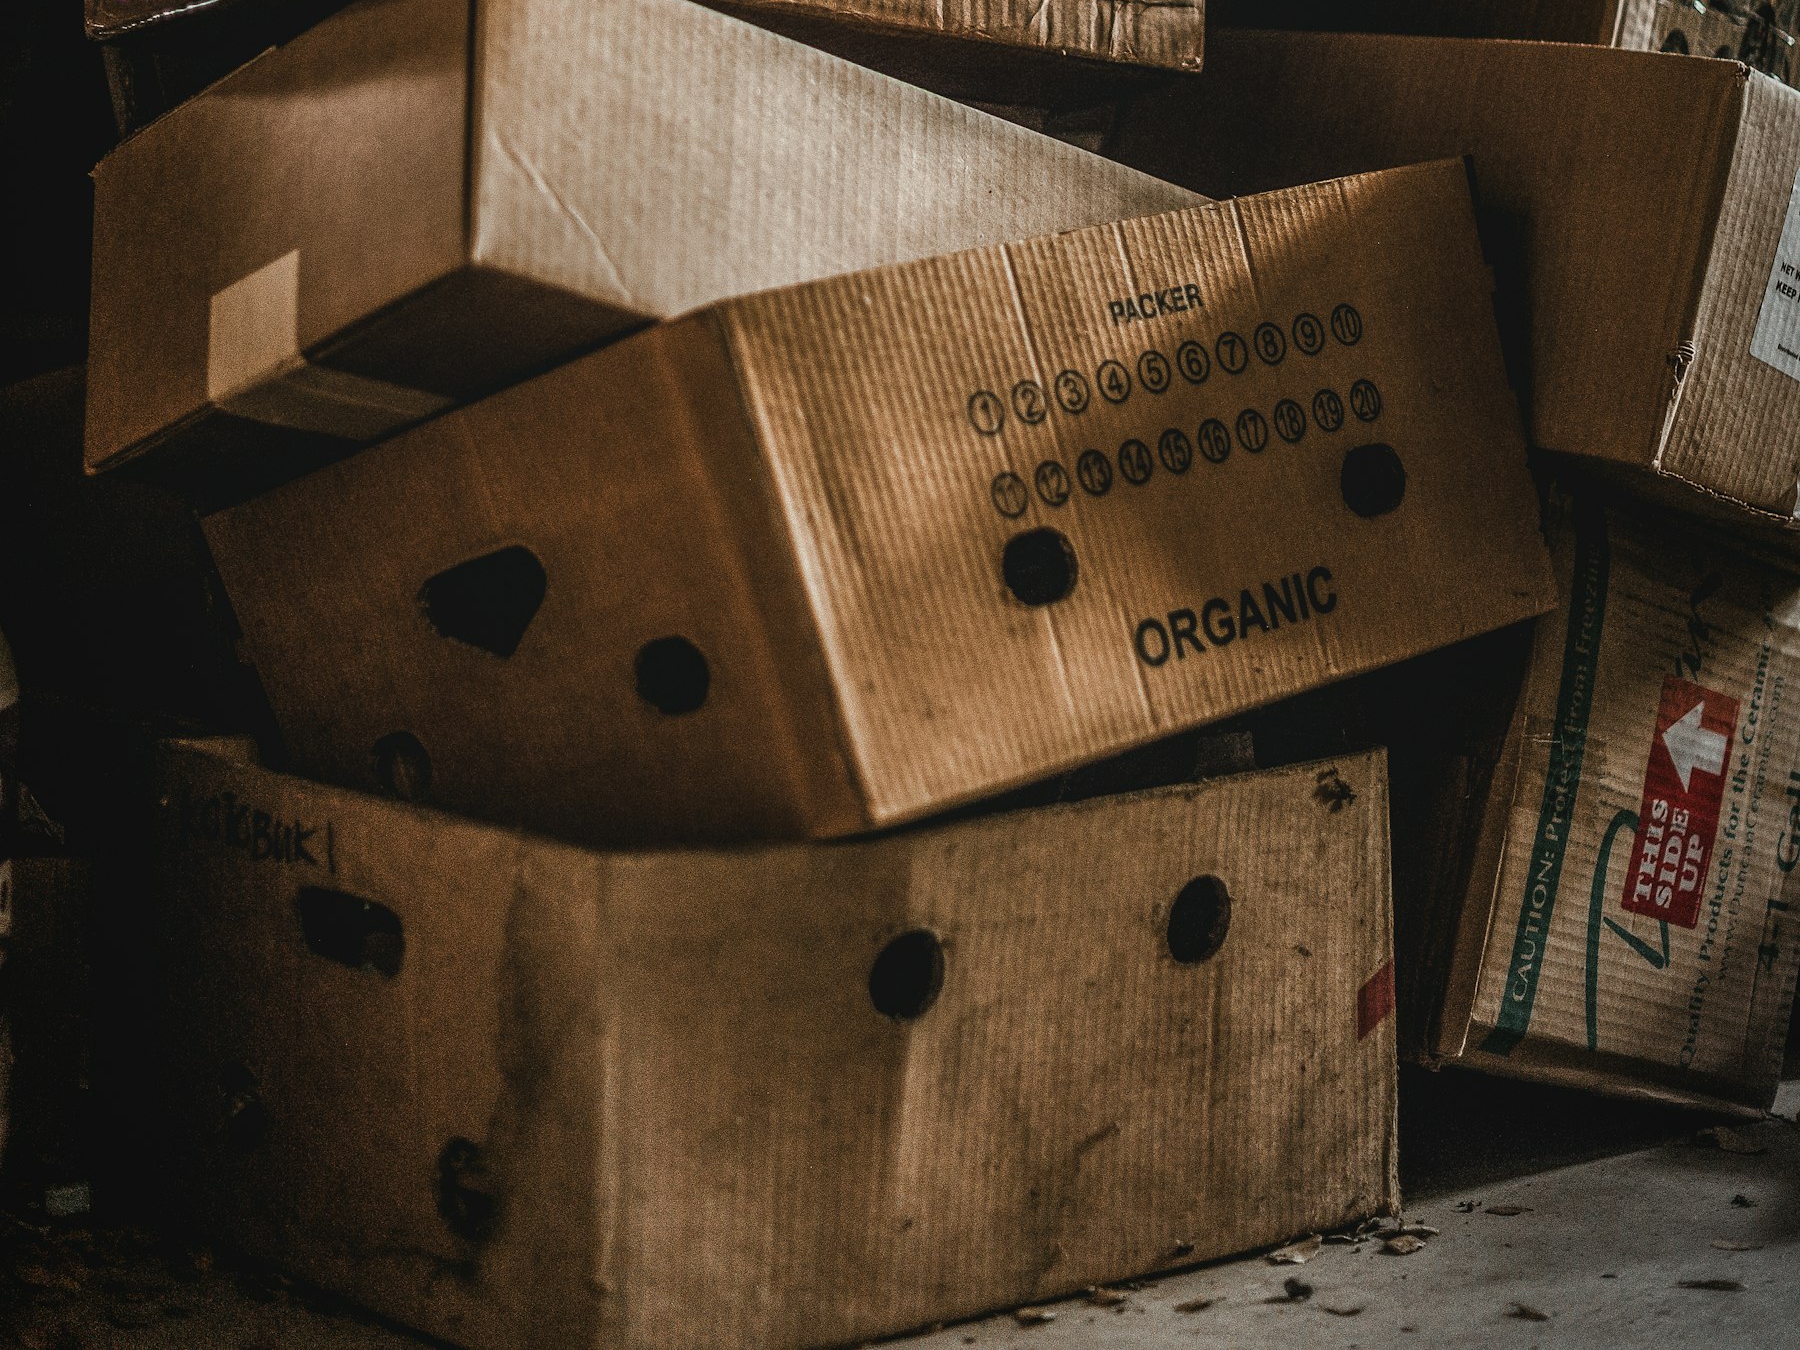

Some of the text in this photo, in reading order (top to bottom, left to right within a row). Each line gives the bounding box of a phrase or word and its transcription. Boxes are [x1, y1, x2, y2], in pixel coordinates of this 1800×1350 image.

[1109, 284, 1204, 326] PACKER
[1776, 280, 1797, 299] KEEP
[1781, 262, 1795, 277] NET
[998, 384, 1379, 513] 11 12 13 14 15 16 17 18 19 20
[1135, 565, 1338, 667] ORGANIC
[1741, 644, 1771, 745] Ceramic
[1723, 803, 1741, 840] for
[1731, 753, 1750, 795] the
[1512, 849, 1555, 1002] CAUTION:
[1563, 665, 1588, 735] From
[1633, 798, 1668, 903] THIS
[1655, 807, 1689, 909] SIDE
[1678, 833, 1704, 893] UP
[1697, 849, 1733, 963] Products
[1758, 898, 1789, 973] 4-1
[1680, 969, 1710, 1070] Quality
